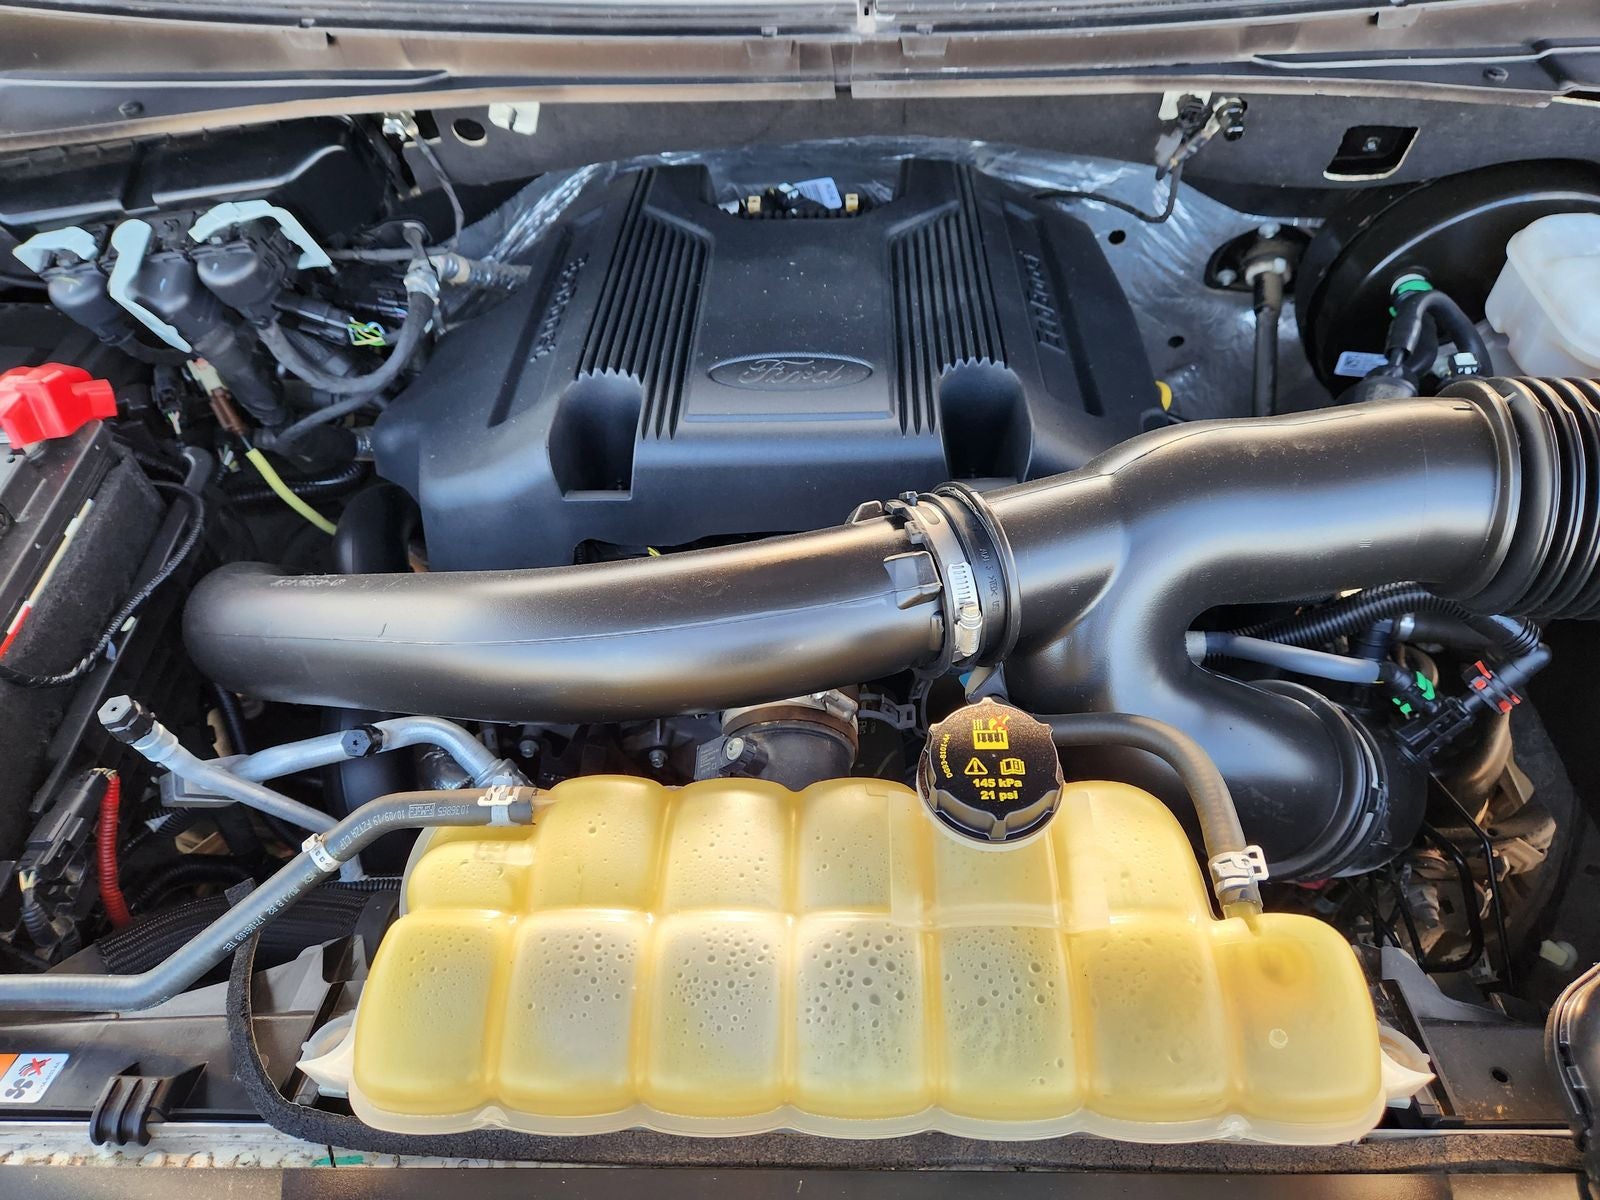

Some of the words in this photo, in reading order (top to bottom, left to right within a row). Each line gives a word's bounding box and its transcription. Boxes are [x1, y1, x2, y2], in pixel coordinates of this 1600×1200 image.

[738, 359, 845, 384] Ford
[973, 778, 996, 788] 145
[998, 778, 1023, 788] kPa
[980, 790, 995, 800] 21
[998, 790, 1019, 801] psi
[234, 915, 266, 942] 17:06:08
